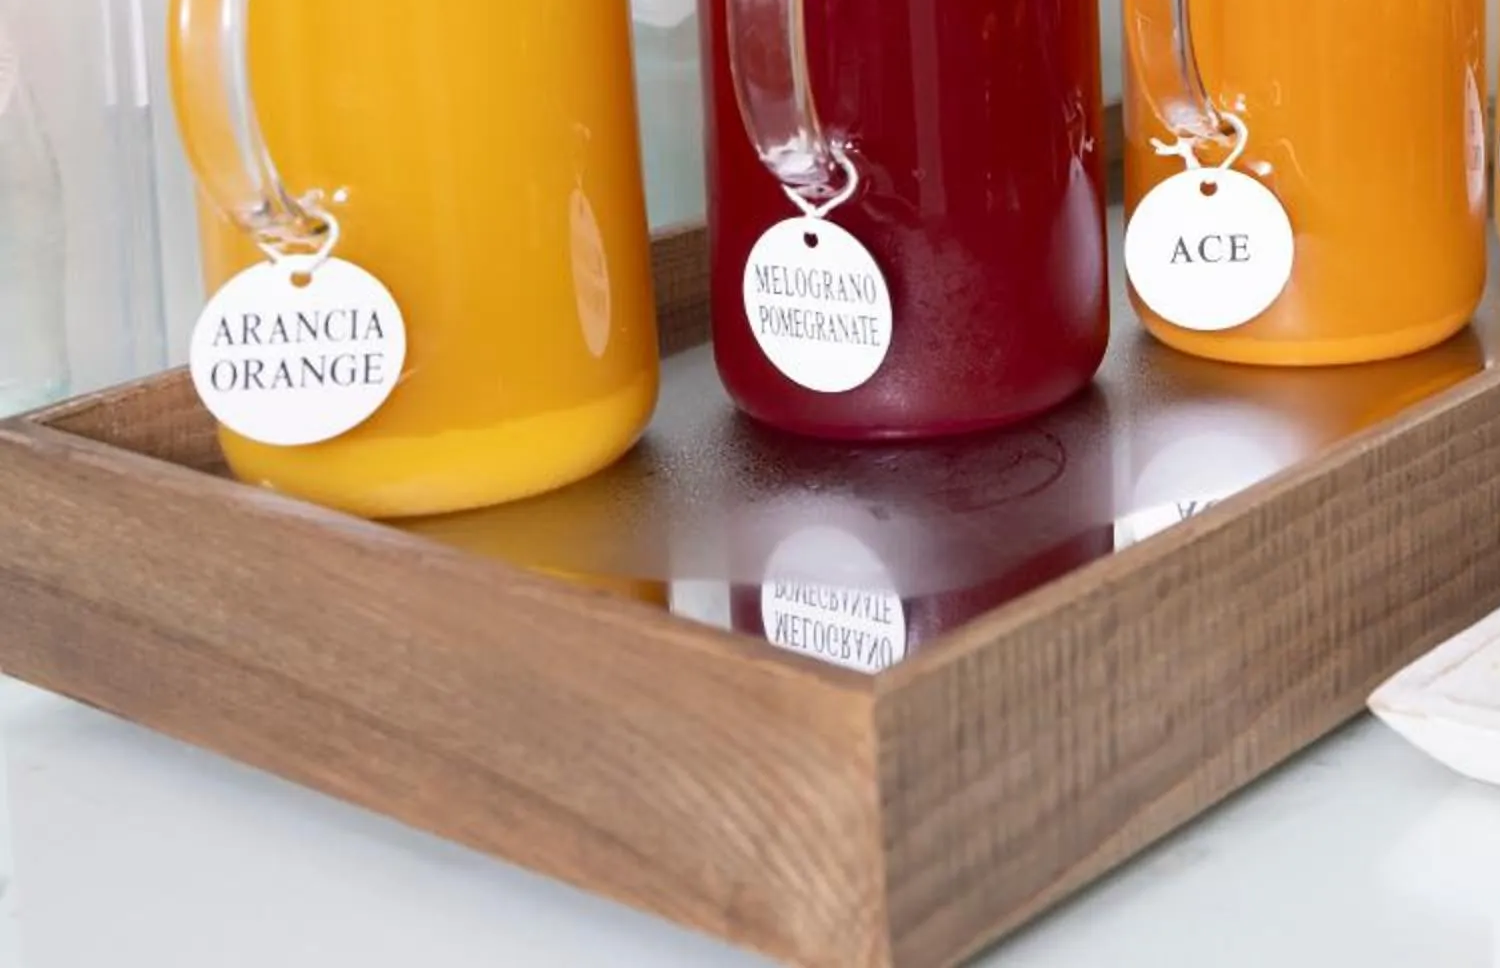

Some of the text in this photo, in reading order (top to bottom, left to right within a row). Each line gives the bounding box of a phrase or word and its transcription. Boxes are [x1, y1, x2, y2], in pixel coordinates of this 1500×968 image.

[1170, 233, 1251, 264] ACE
[755, 263, 877, 305] MELOGRANO
[212, 308, 385, 347] ARANCIA
[758, 305, 881, 348] POMEGRANATE
[210, 352, 385, 393] ORANGE
